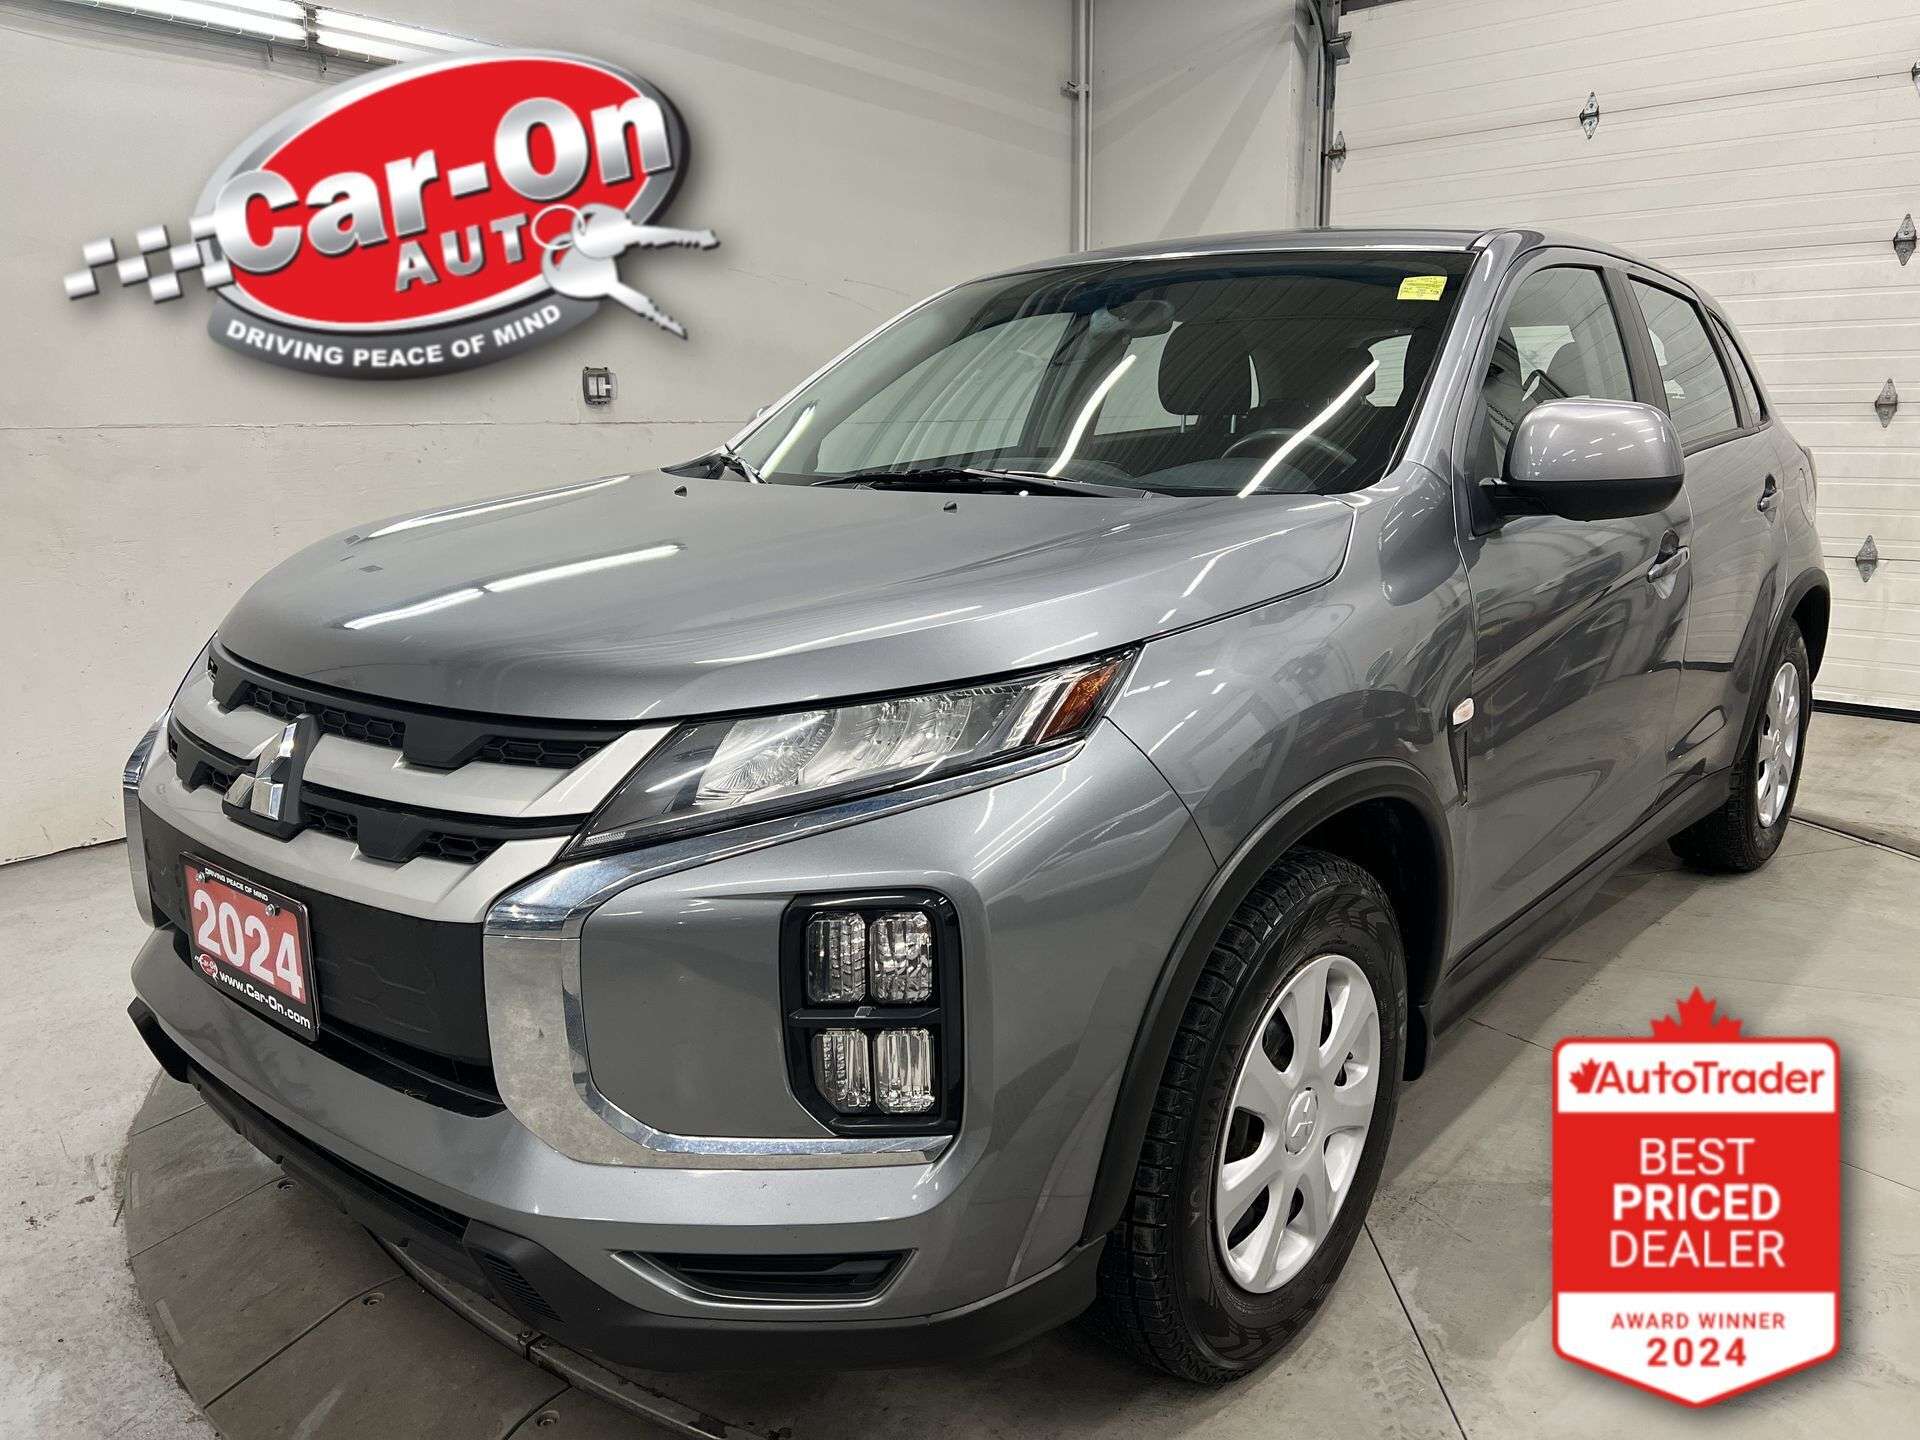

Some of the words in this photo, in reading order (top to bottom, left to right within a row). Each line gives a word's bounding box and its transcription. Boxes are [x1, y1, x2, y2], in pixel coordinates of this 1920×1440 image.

[204, 867, 226, 882] DRIVING
[226, 877, 244, 891] PEACE
[244, 885, 253, 894] OF
[193, 889, 303, 1000] 2024
[219, 971, 311, 1029] www.Car-On.com
